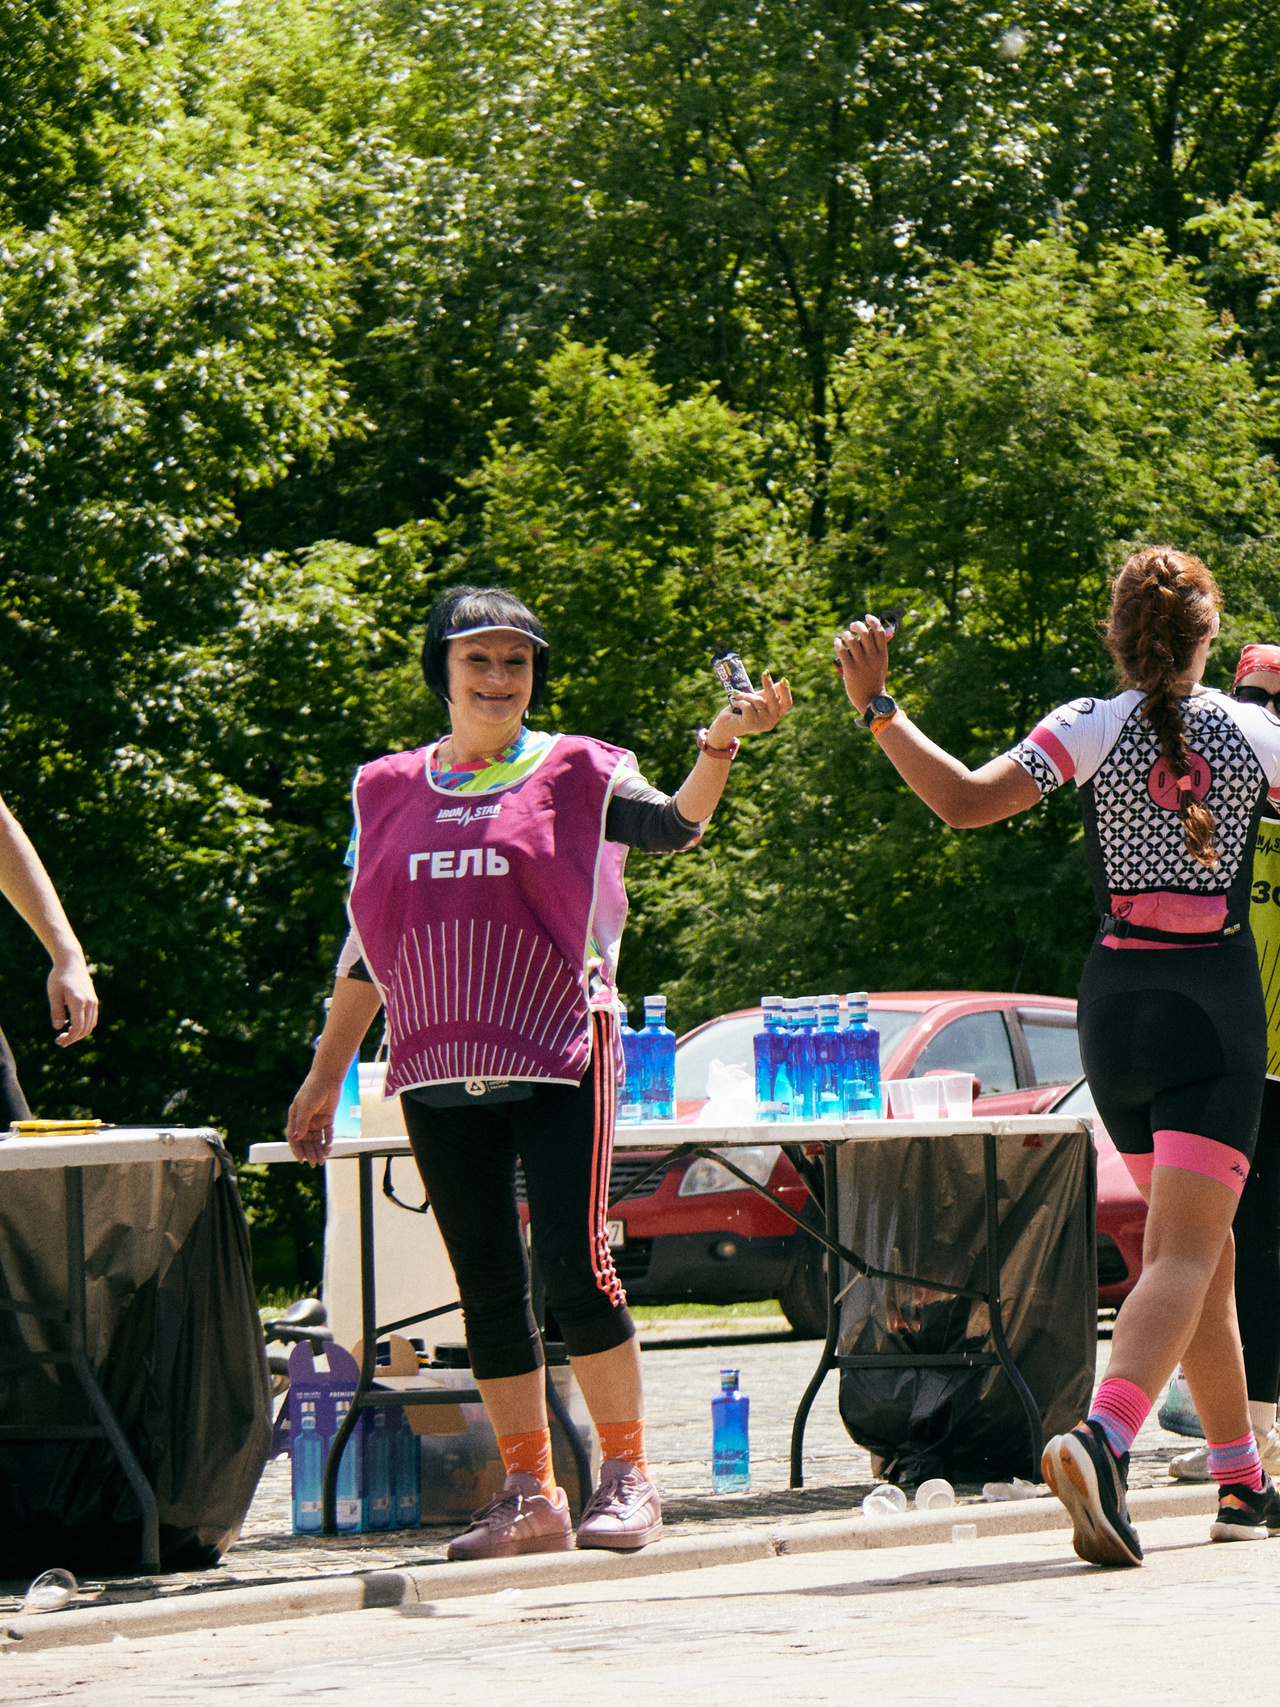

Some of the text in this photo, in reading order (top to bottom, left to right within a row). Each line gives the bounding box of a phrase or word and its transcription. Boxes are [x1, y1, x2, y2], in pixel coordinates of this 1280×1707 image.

[716, 663, 729, 681] GEL
[437, 803, 502, 819] IRON STAR
[409, 848, 509, 881] ГЕЛЬ
